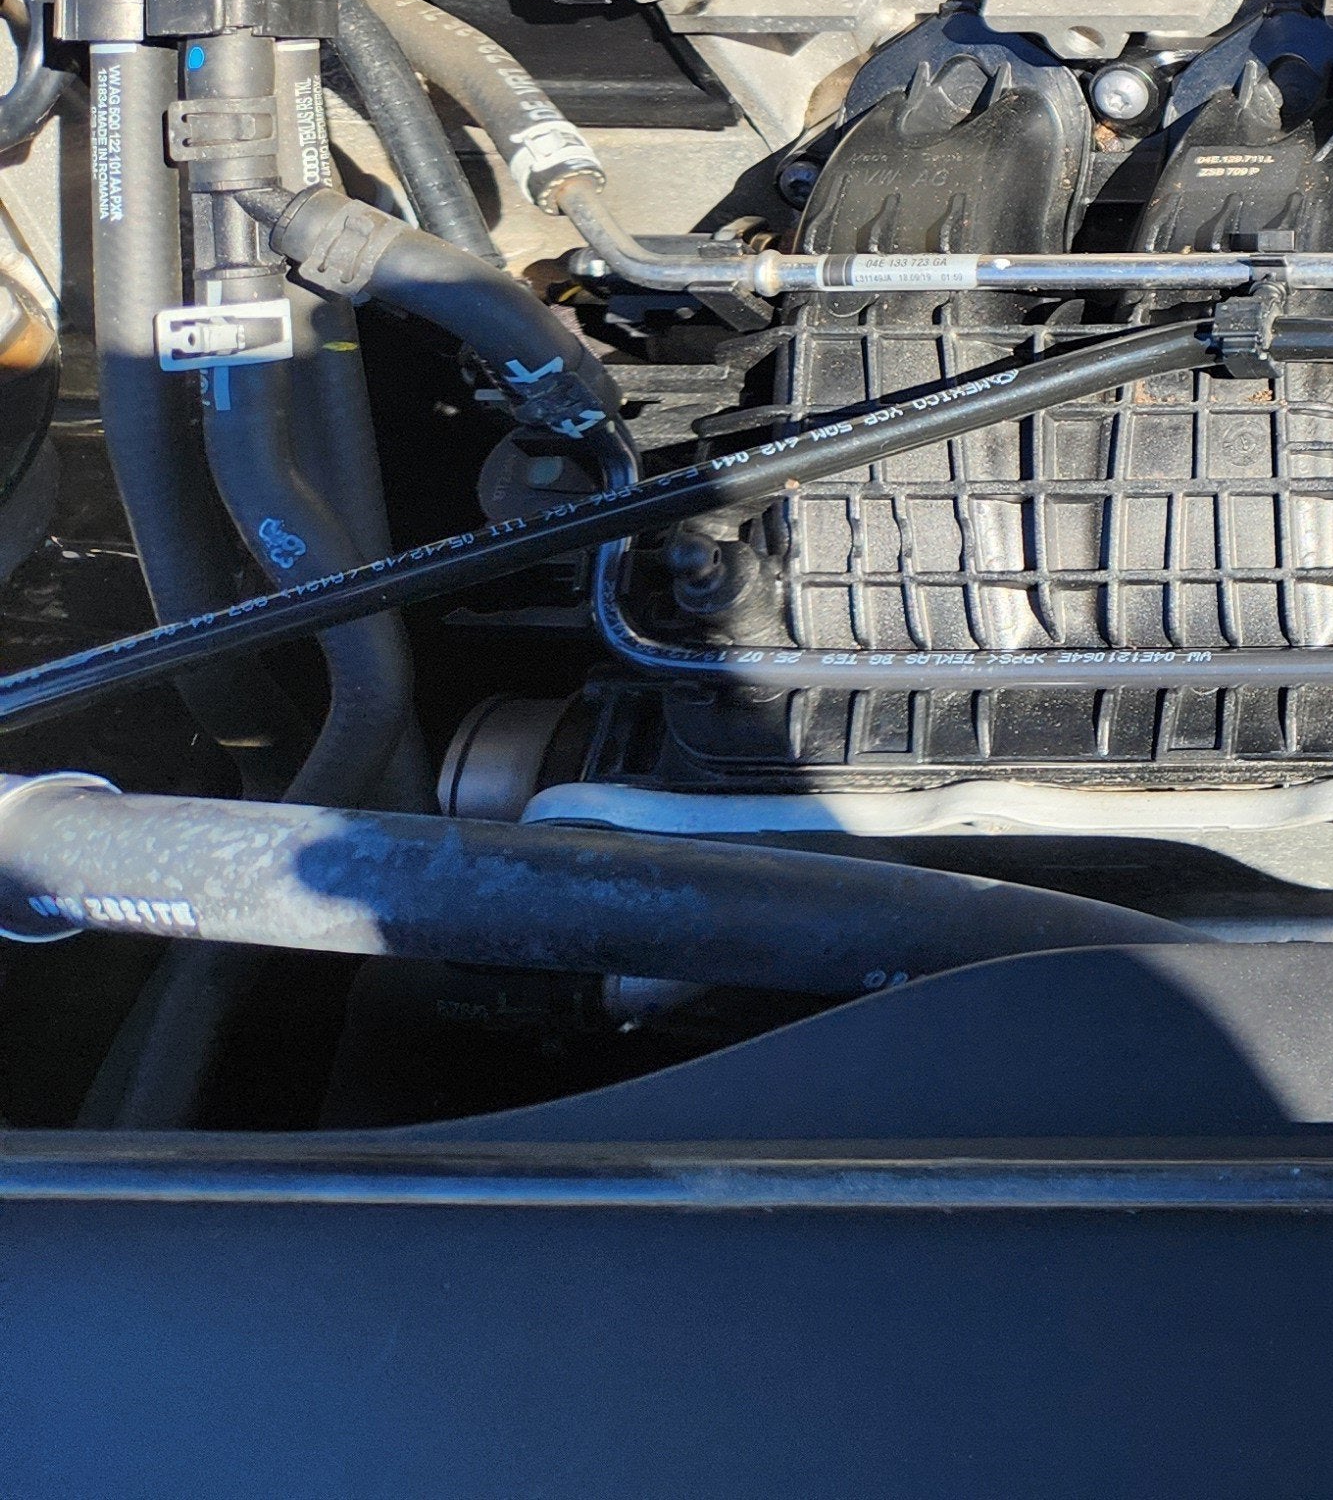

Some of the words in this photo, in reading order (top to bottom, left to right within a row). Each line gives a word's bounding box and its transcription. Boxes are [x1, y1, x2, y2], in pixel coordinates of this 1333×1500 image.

[109, 65, 120, 86] VW
[97, 68, 107, 108] 131834
[109, 86, 120, 104] AG
[295, 75, 309, 97] TKL
[296, 95, 311, 111] RS
[98, 111, 107, 145] MADE
[296, 108, 312, 150] TEKLAS
[109, 132, 121, 152] 122
[98, 148, 107, 160] IN
[109, 156, 121, 174] 101
[98, 163, 108, 219] ROMANIA
[109, 177, 121, 192] AA
[110, 195, 123, 221] PXR
[865, 258, 886, 269] 04E
[888, 258, 910, 269] 133
[910, 257, 930, 268] 723
[931, 257, 948, 268] GA
[910, 377, 992, 411] MEXICO
[861, 403, 904, 426] YCP
[809, 419, 853, 442] 5QM
[758, 434, 801, 457] 612
[709, 449, 749, 471] 041
[821, 653, 857, 664] TE9
[868, 653, 895, 664] BG
[905, 652, 975, 664] TEKLAS
[986, 652, 1047, 664] >PPS<
[1057, 651, 1175, 662] 04E121064E
